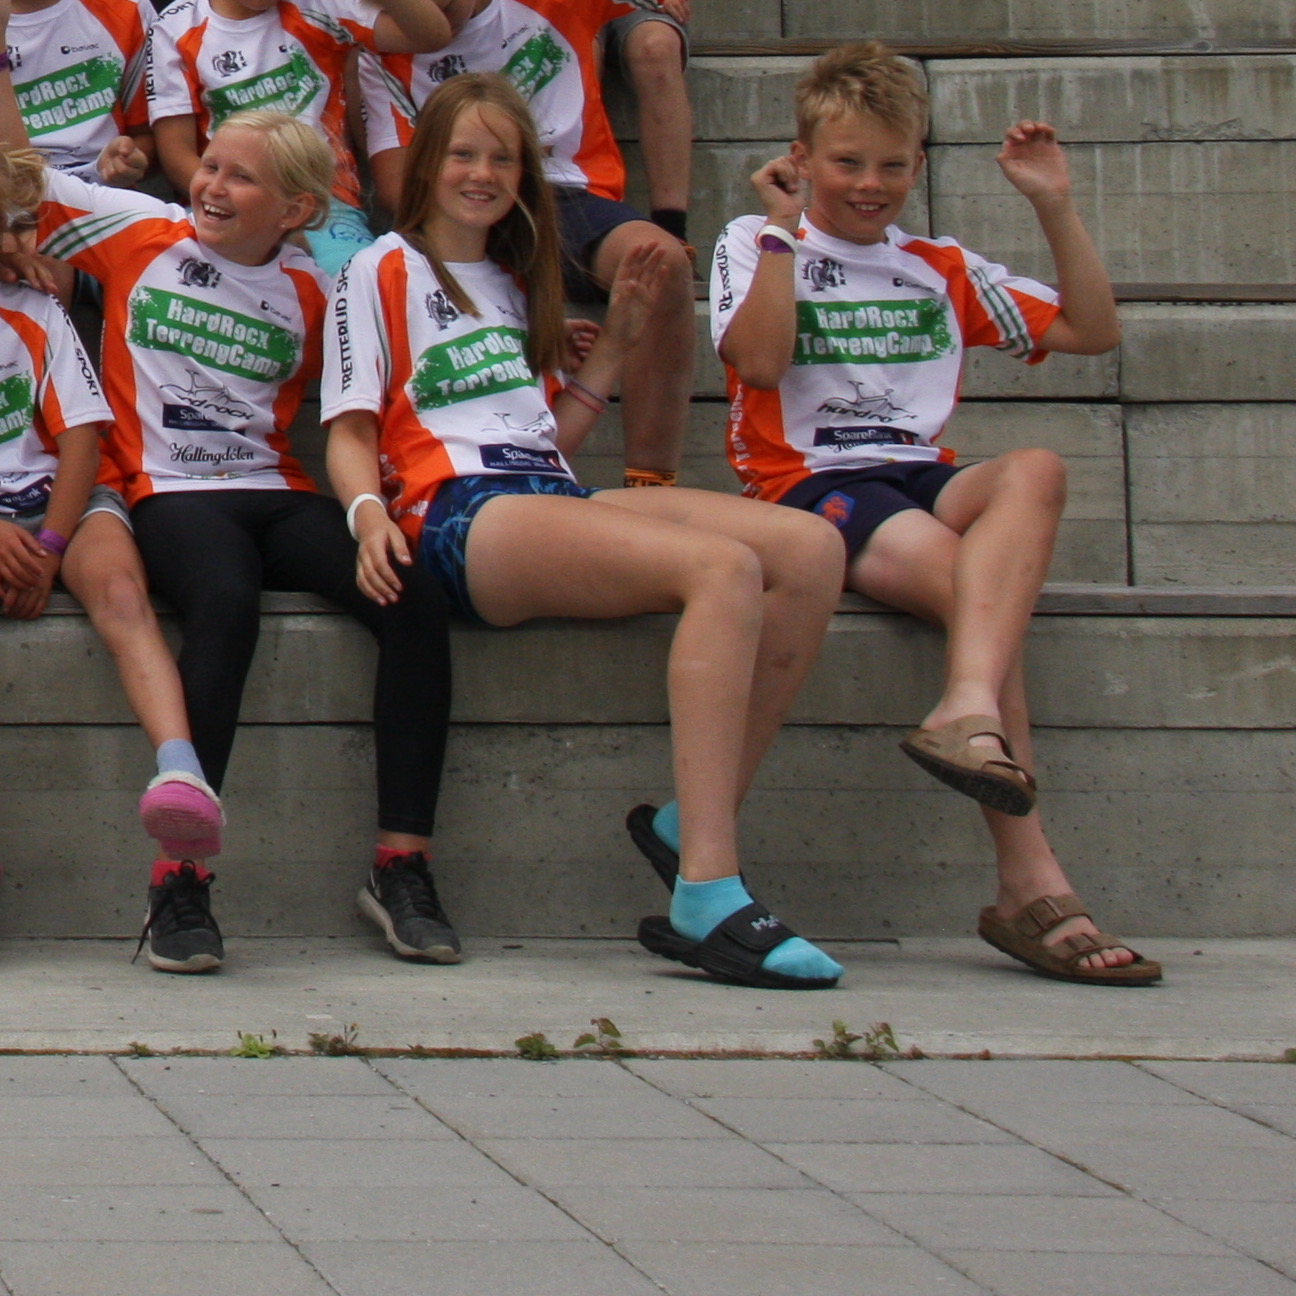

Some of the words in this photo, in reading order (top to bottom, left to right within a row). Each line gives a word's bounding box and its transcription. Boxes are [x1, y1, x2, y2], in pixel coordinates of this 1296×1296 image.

[165, 297, 270, 351] HardRocx
[816, 306, 920, 330] HardRocx
[73, 346, 101, 399] SPORT
[145, 317, 283, 380] TerrengCamp
